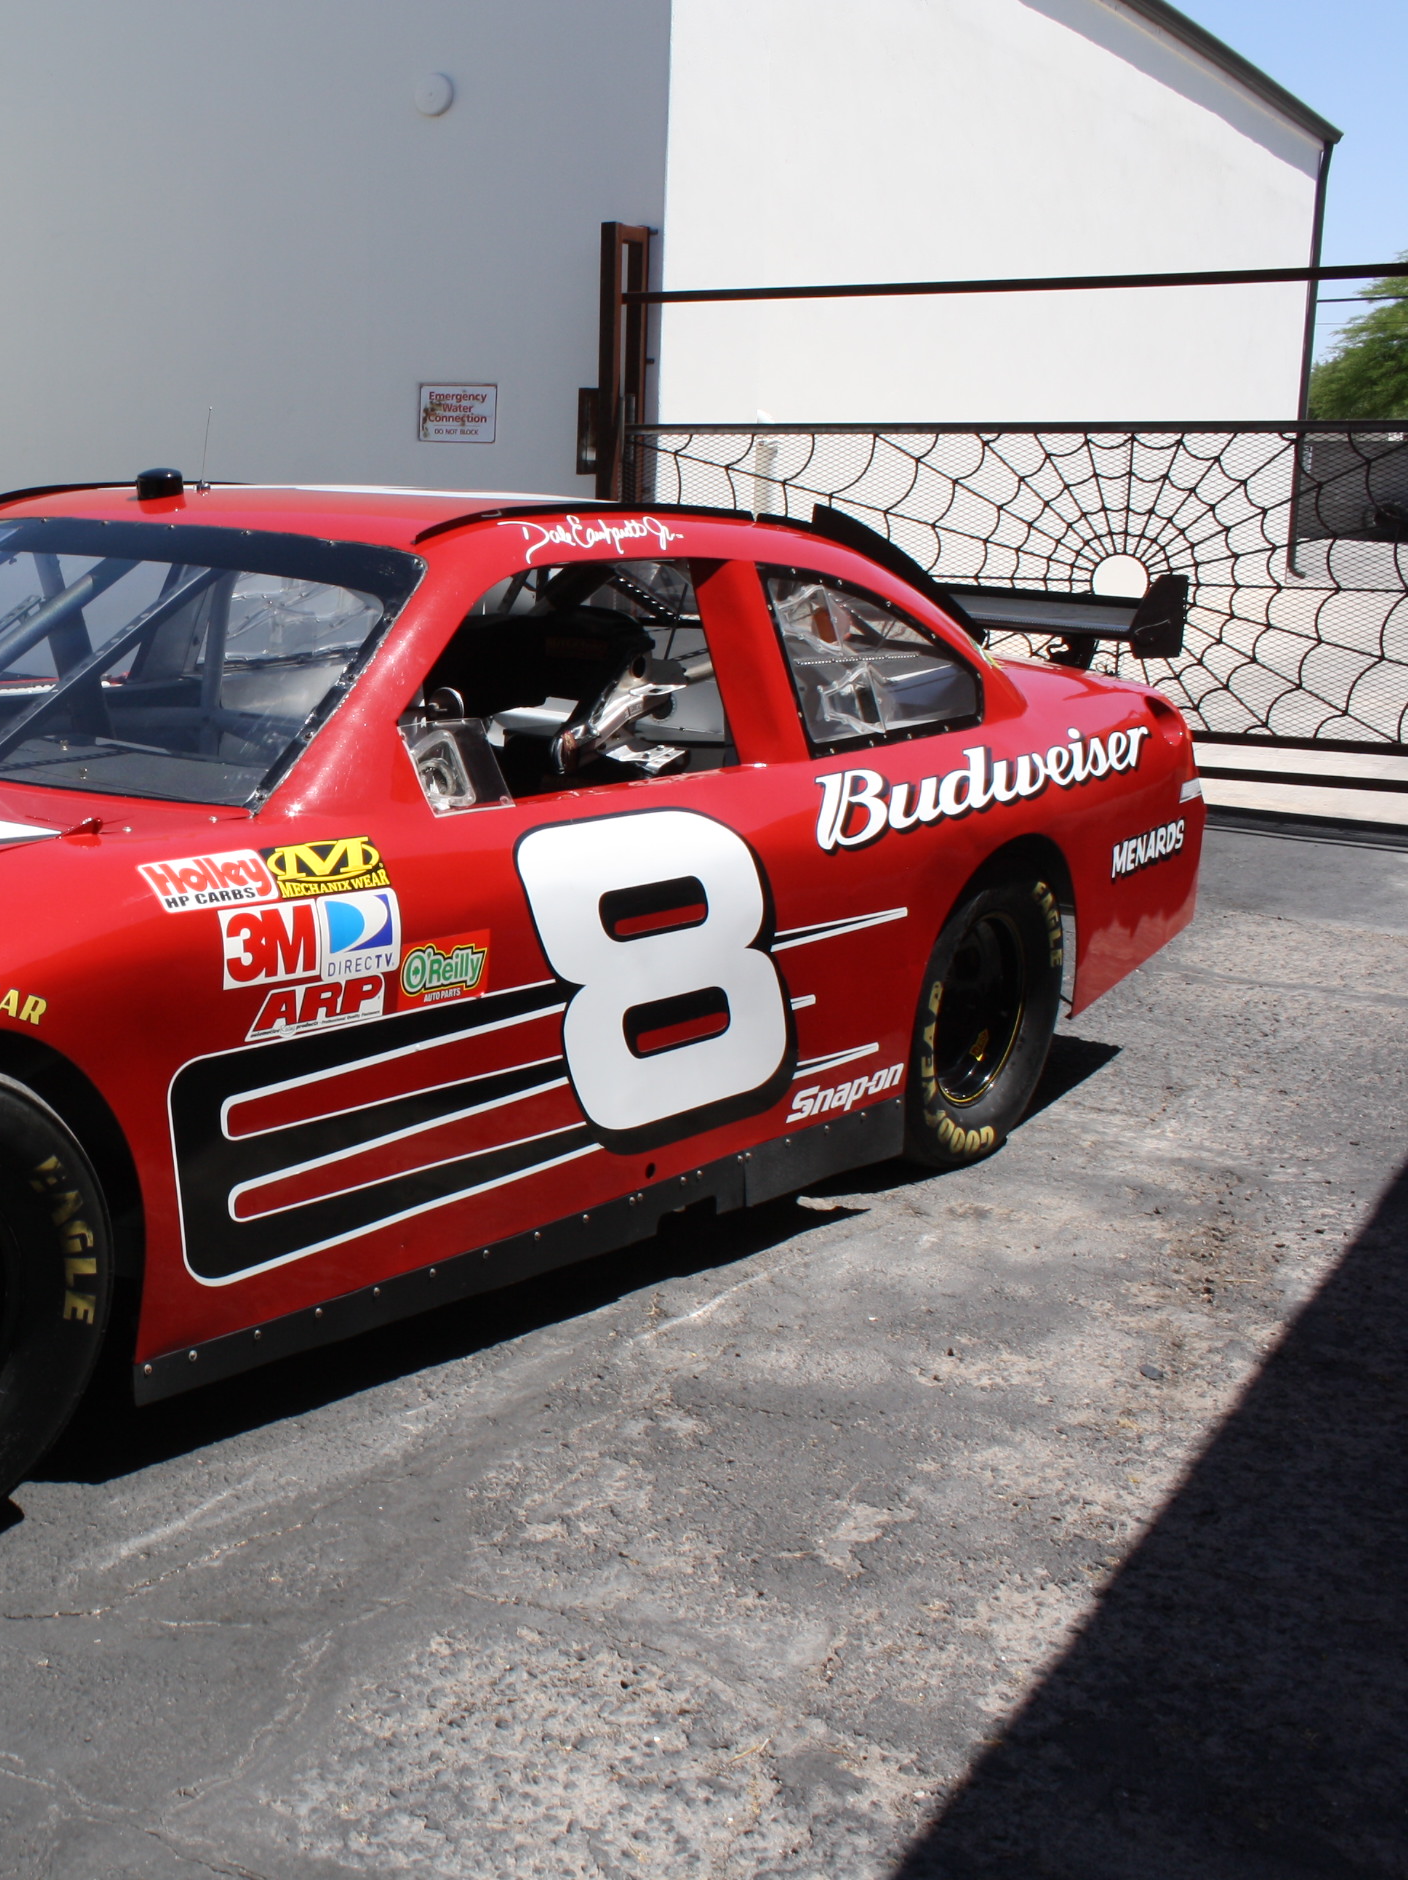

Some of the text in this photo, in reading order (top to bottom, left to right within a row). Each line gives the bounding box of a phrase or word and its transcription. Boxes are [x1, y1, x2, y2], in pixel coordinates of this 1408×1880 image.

[428, 414, 487, 424] Connection
[429, 391, 487, 403] Emergency
[442, 403, 474, 413] Water
[459, 428, 480, 436] BLOCK
[815, 726, 1149, 852] Budweiser
[1111, 816, 1185, 879] MENARDS
[141, 856, 273, 897] Holley
[165, 886, 256, 910] HP CARBS
[278, 869, 390, 898] MECHANIX WEAR
[226, 902, 318, 983] 3M
[1031, 880, 1063, 968] EAGLE
[327, 952, 394, 978] DIRECTV
[403, 944, 487, 995] O'Reilly
[515, 809, 789, 1132] 8
[252, 974, 384, 1032] ARP
[423, 987, 461, 1003] AUTO PARTS
[786, 1062, 904, 1124] Snap-on
[32, 1154, 98, 1326] EAGLE
